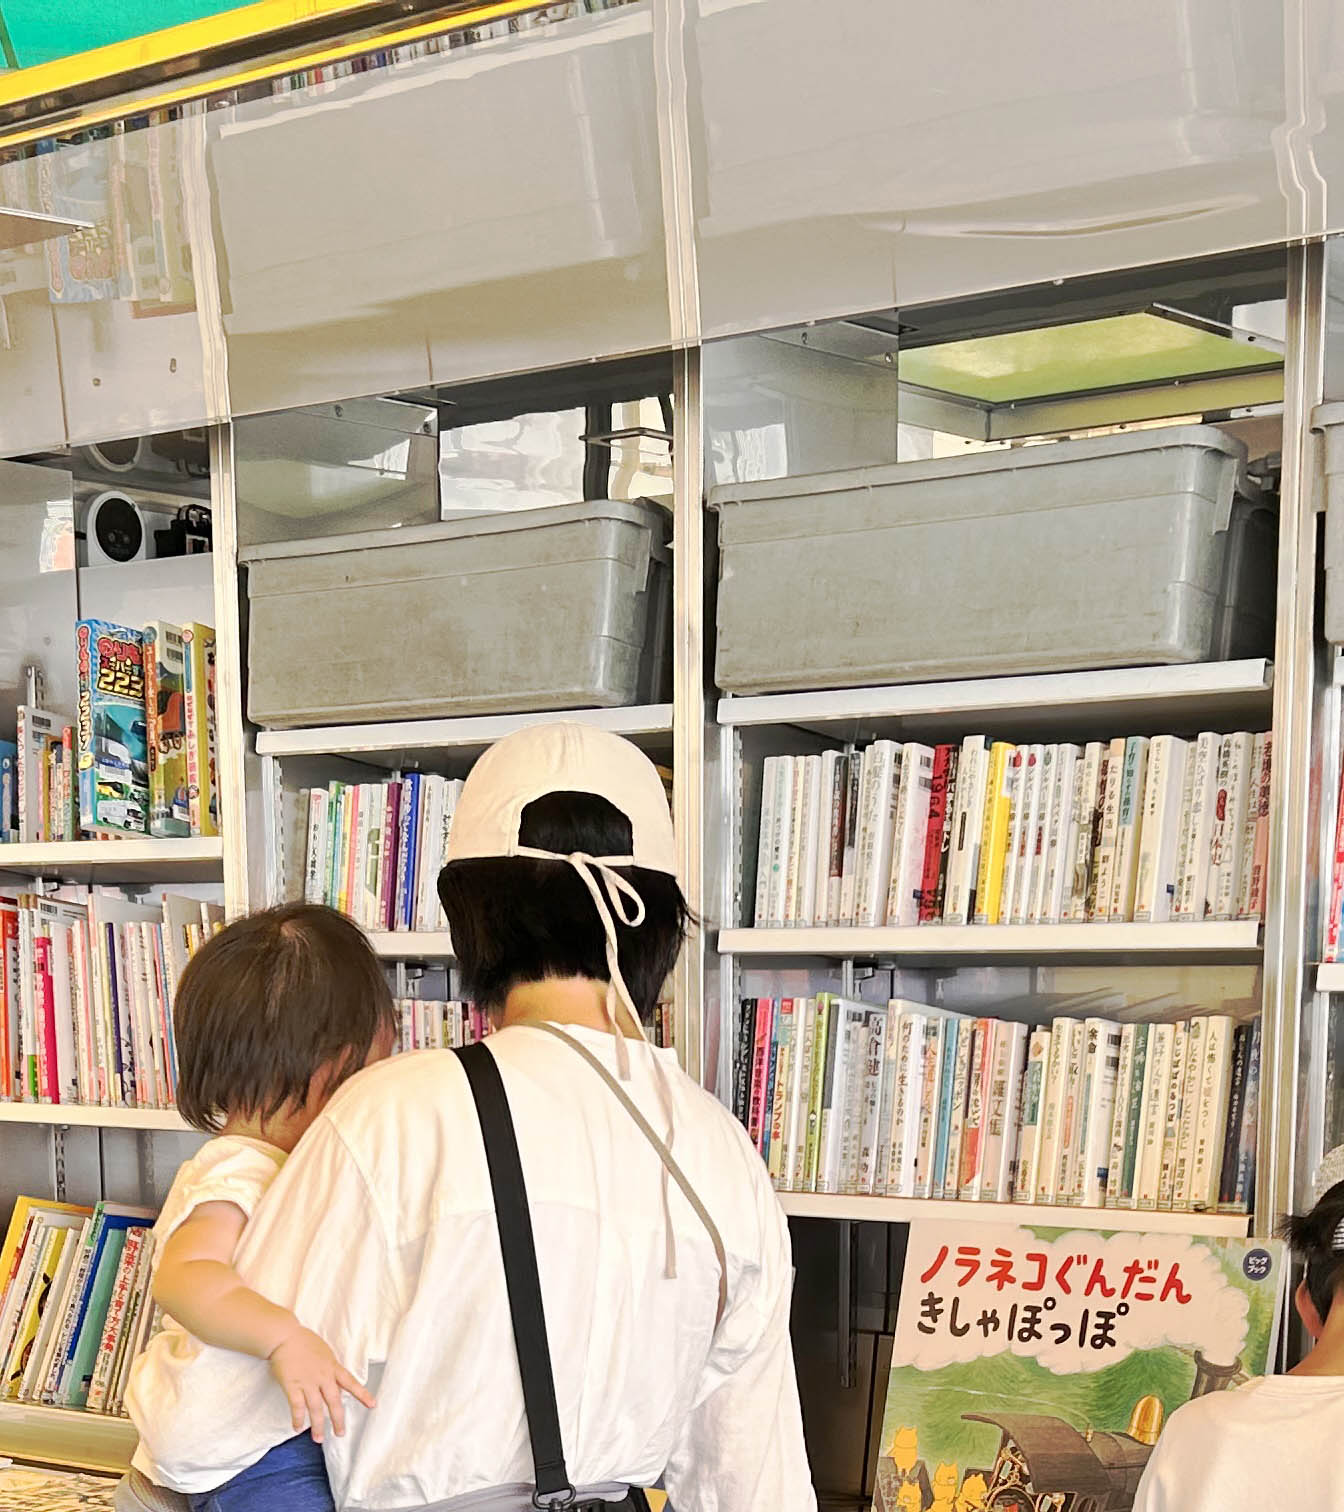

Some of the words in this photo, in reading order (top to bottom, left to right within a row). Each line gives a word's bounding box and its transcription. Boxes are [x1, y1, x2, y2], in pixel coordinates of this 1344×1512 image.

[865, 1015, 885, 1078] 高倉健
[896, 1021, 914, 1126] 何のために生きるのか
[920, 1244, 1193, 1305] ノラネコぐんだん
[916, 1292, 1131, 1350] きしゃぽっぽ
